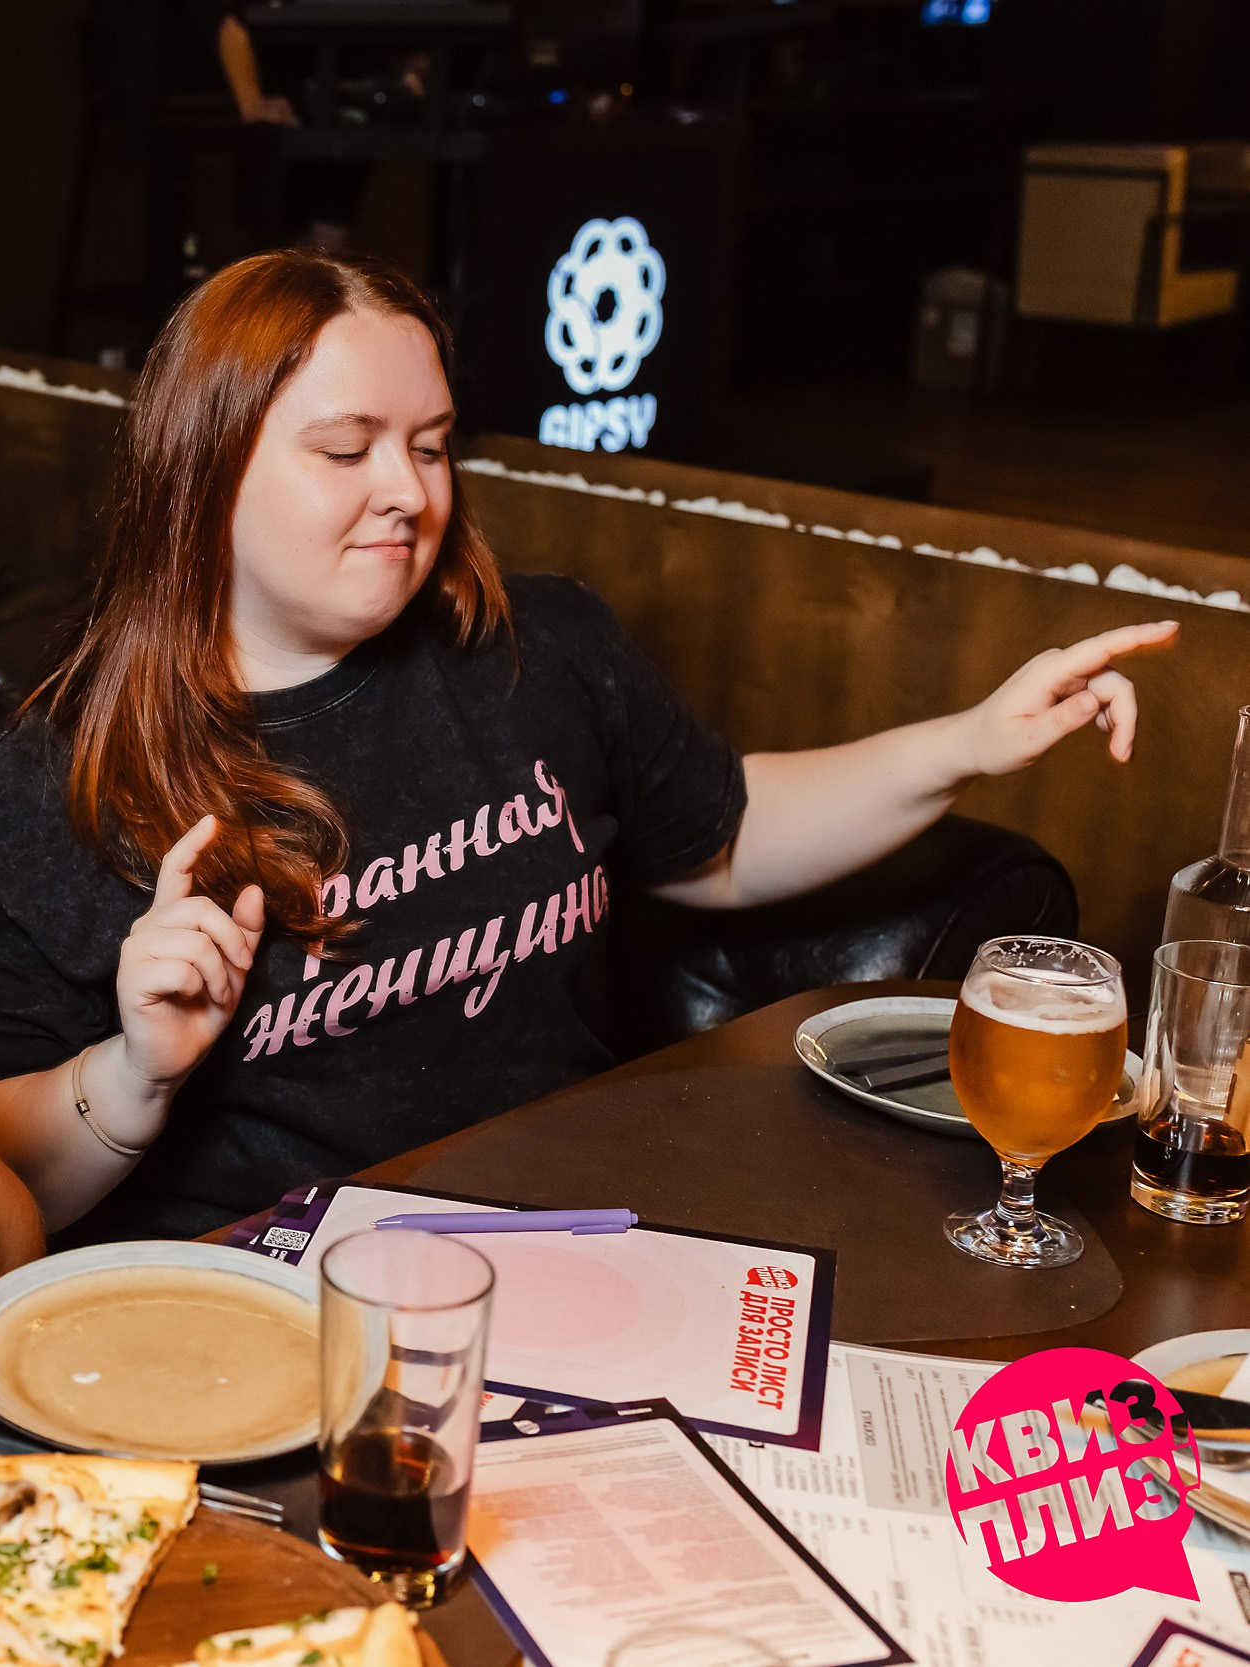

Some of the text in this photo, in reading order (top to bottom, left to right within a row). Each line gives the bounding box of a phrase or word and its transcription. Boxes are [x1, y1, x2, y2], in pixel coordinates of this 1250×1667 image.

[538, 393, 657, 452] GIPSY
[302, 759, 585, 981] ранная
[243, 865, 609, 1062] женщина
[731, 1290, 768, 1392] ДЛЯ ЗАПИСИ
[758, 1297, 794, 1410] ПРОСТО ЛИСТ
[861, 1409, 876, 1447] COCKTAILS
